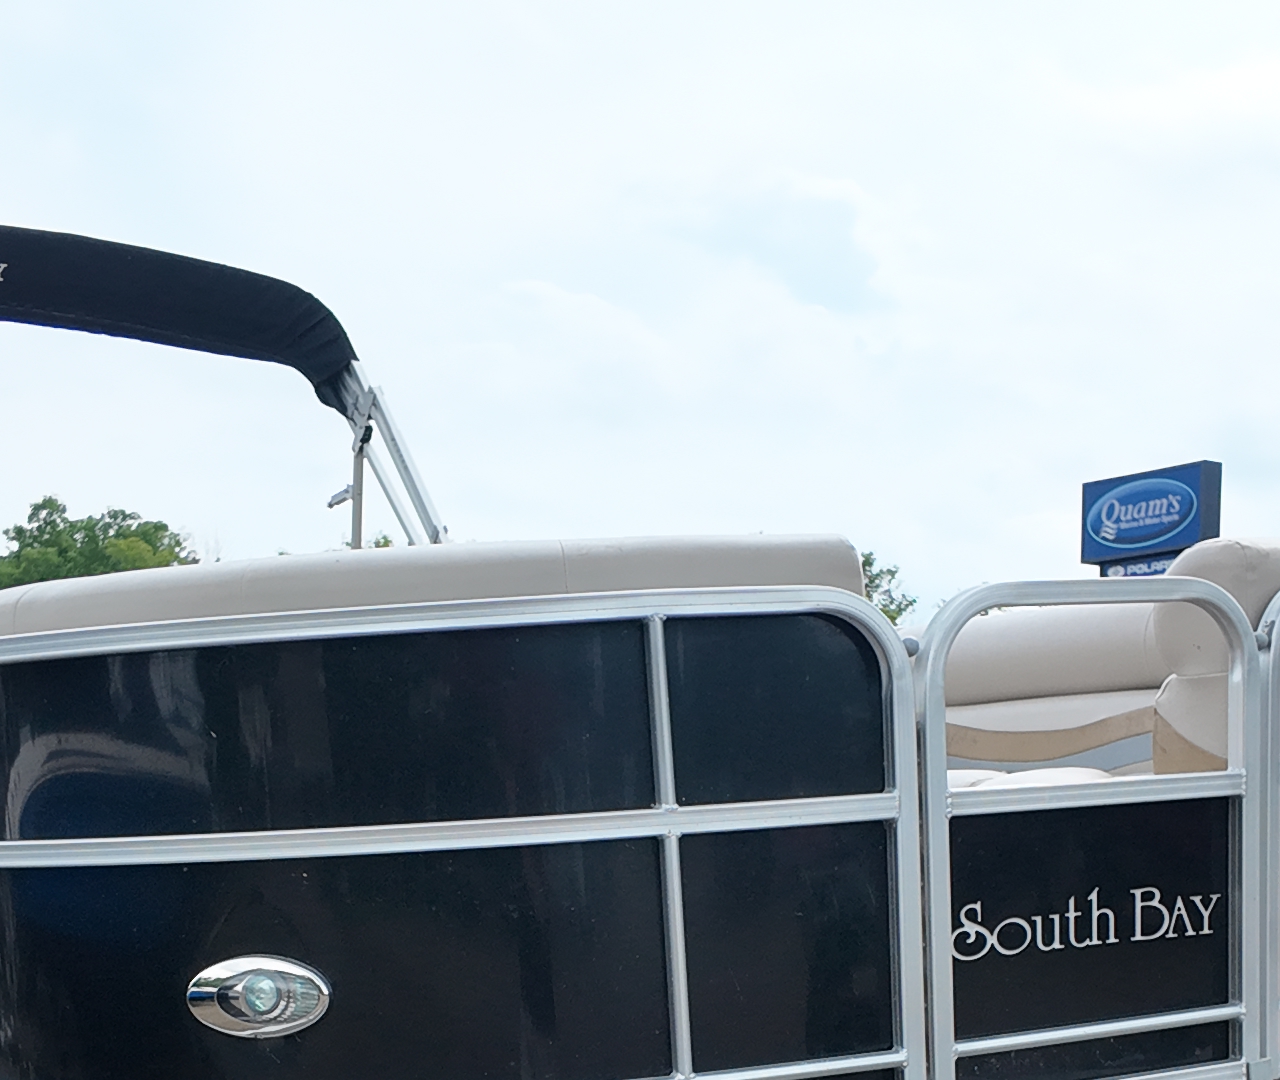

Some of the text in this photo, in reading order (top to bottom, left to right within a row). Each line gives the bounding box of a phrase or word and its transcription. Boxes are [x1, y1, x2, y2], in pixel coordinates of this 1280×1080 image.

[1100, 494, 1181, 532] Quam's
[951, 886, 1222, 961] South BAY
